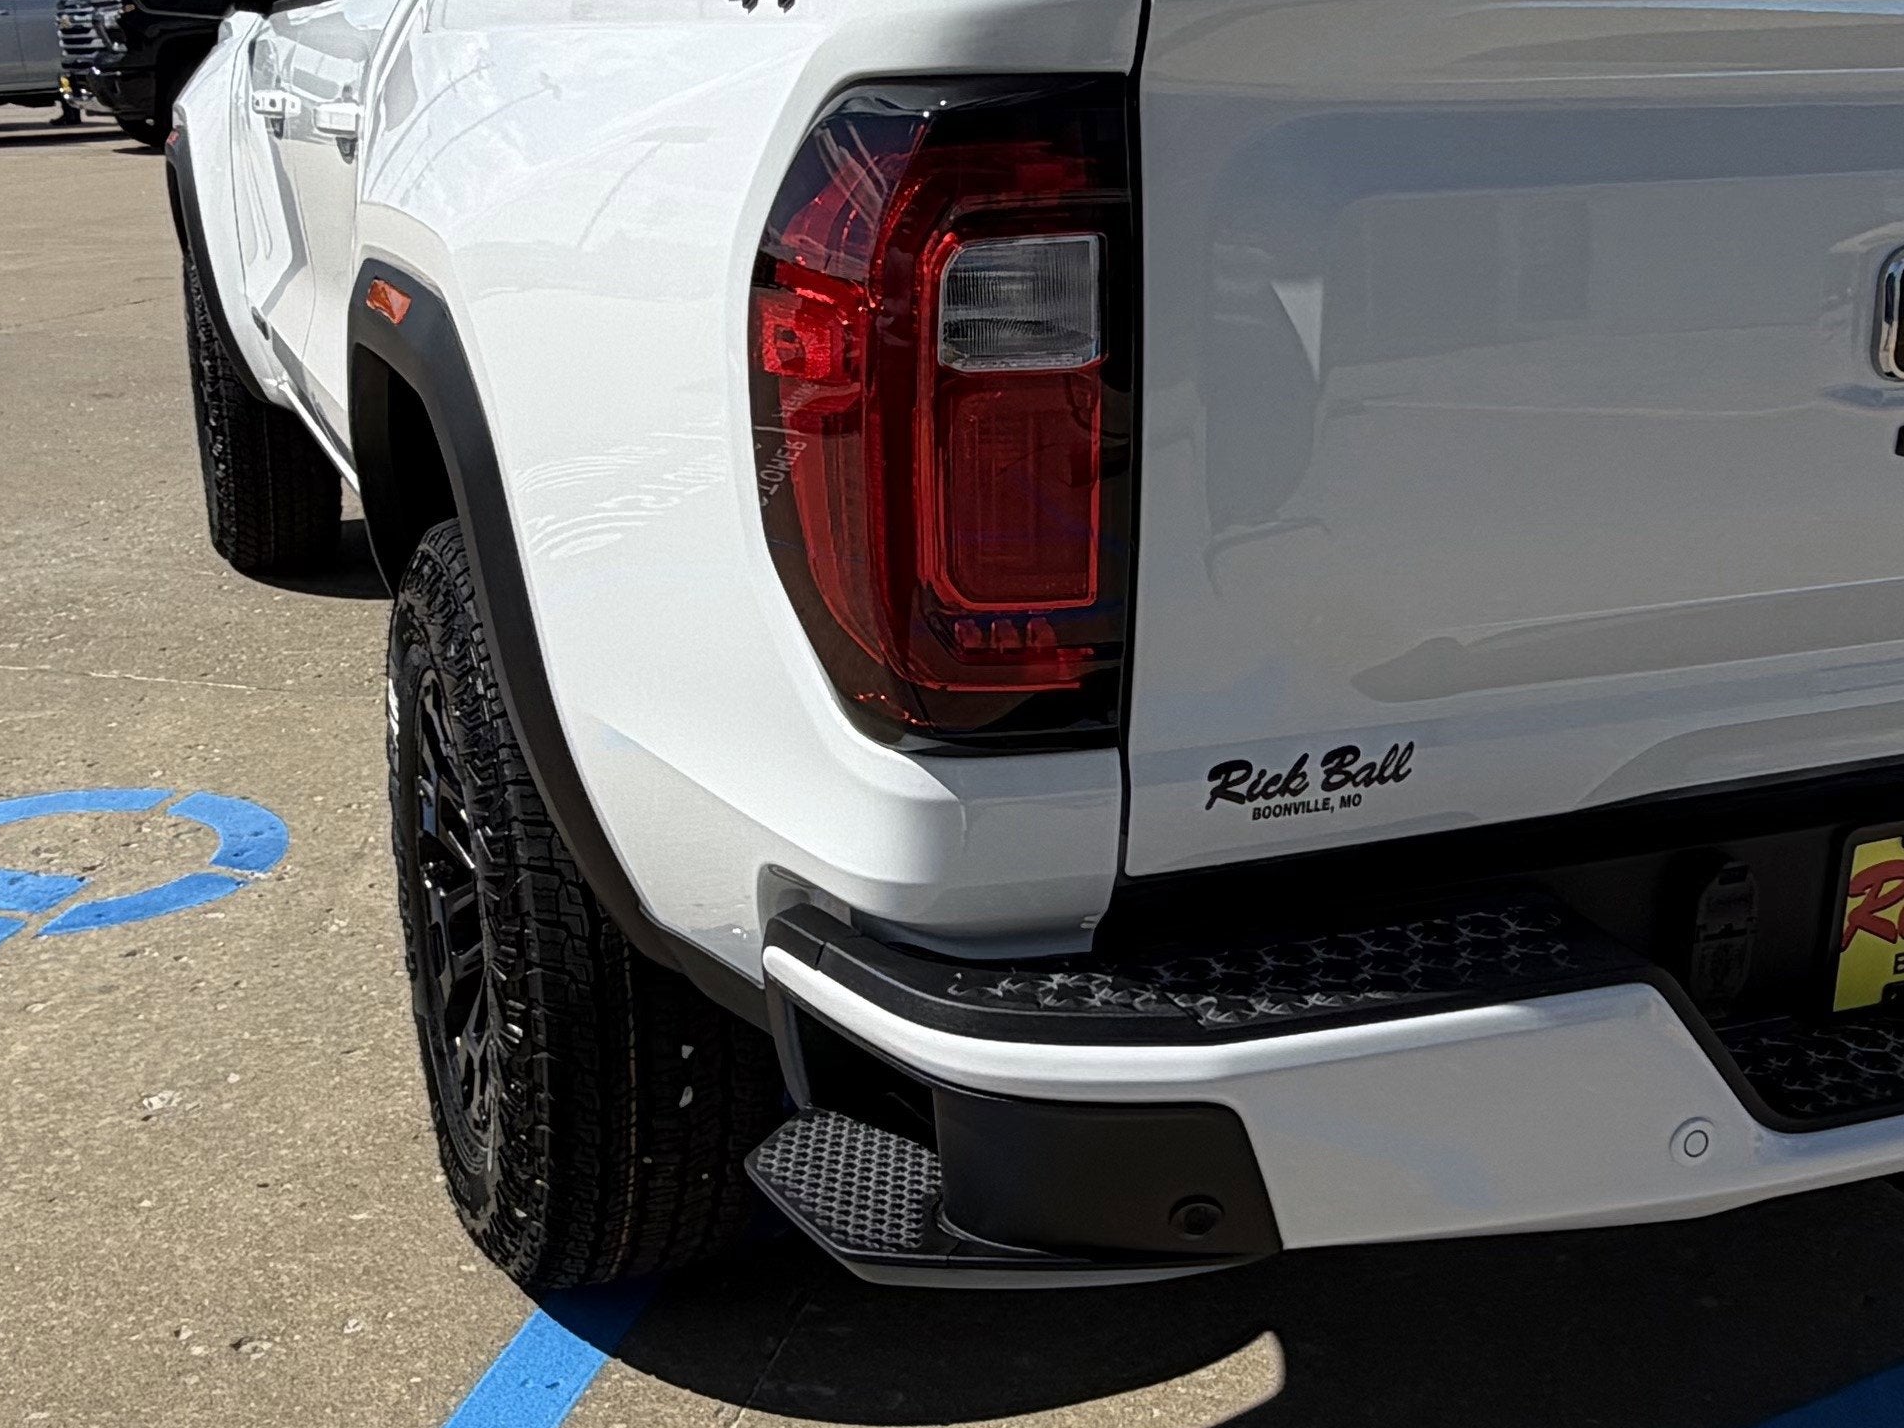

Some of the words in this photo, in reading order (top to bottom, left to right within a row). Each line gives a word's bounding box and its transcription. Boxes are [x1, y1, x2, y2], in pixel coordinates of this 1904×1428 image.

[1205, 752, 1310, 810] Rick
[1320, 740, 1415, 792] Ball
[1252, 797, 1335, 821] BOONVILLE,
[1340, 793, 1362, 809] MO
